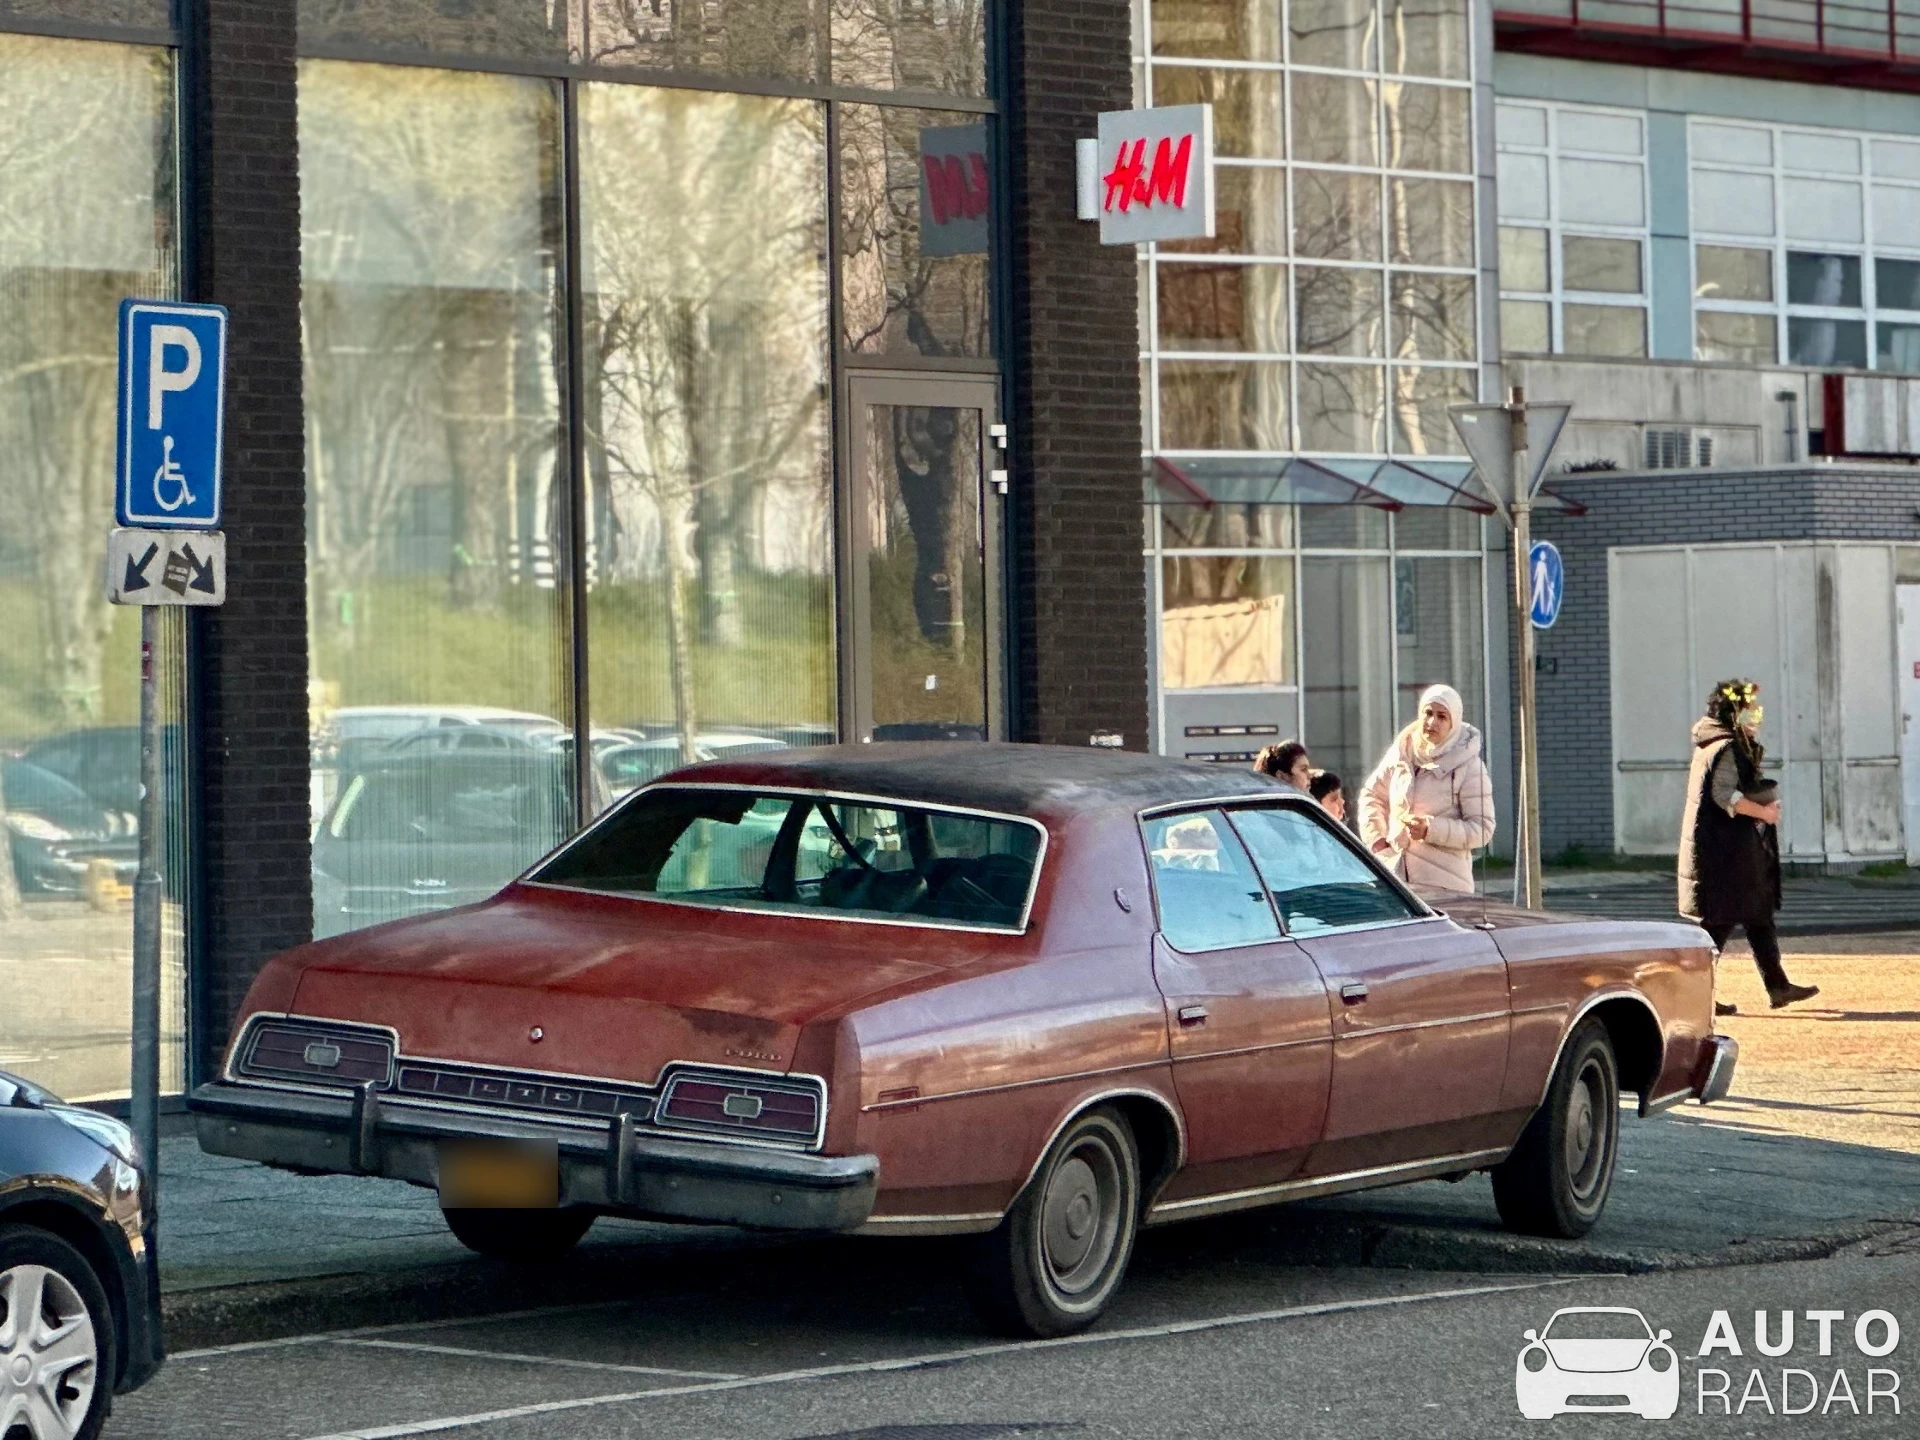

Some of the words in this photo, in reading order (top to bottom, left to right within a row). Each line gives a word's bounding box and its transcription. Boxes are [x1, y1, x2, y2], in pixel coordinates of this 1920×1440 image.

[1103, 133, 1192, 213] H&M
[148, 324, 202, 430] P
[725, 1048, 782, 1061] FORD
